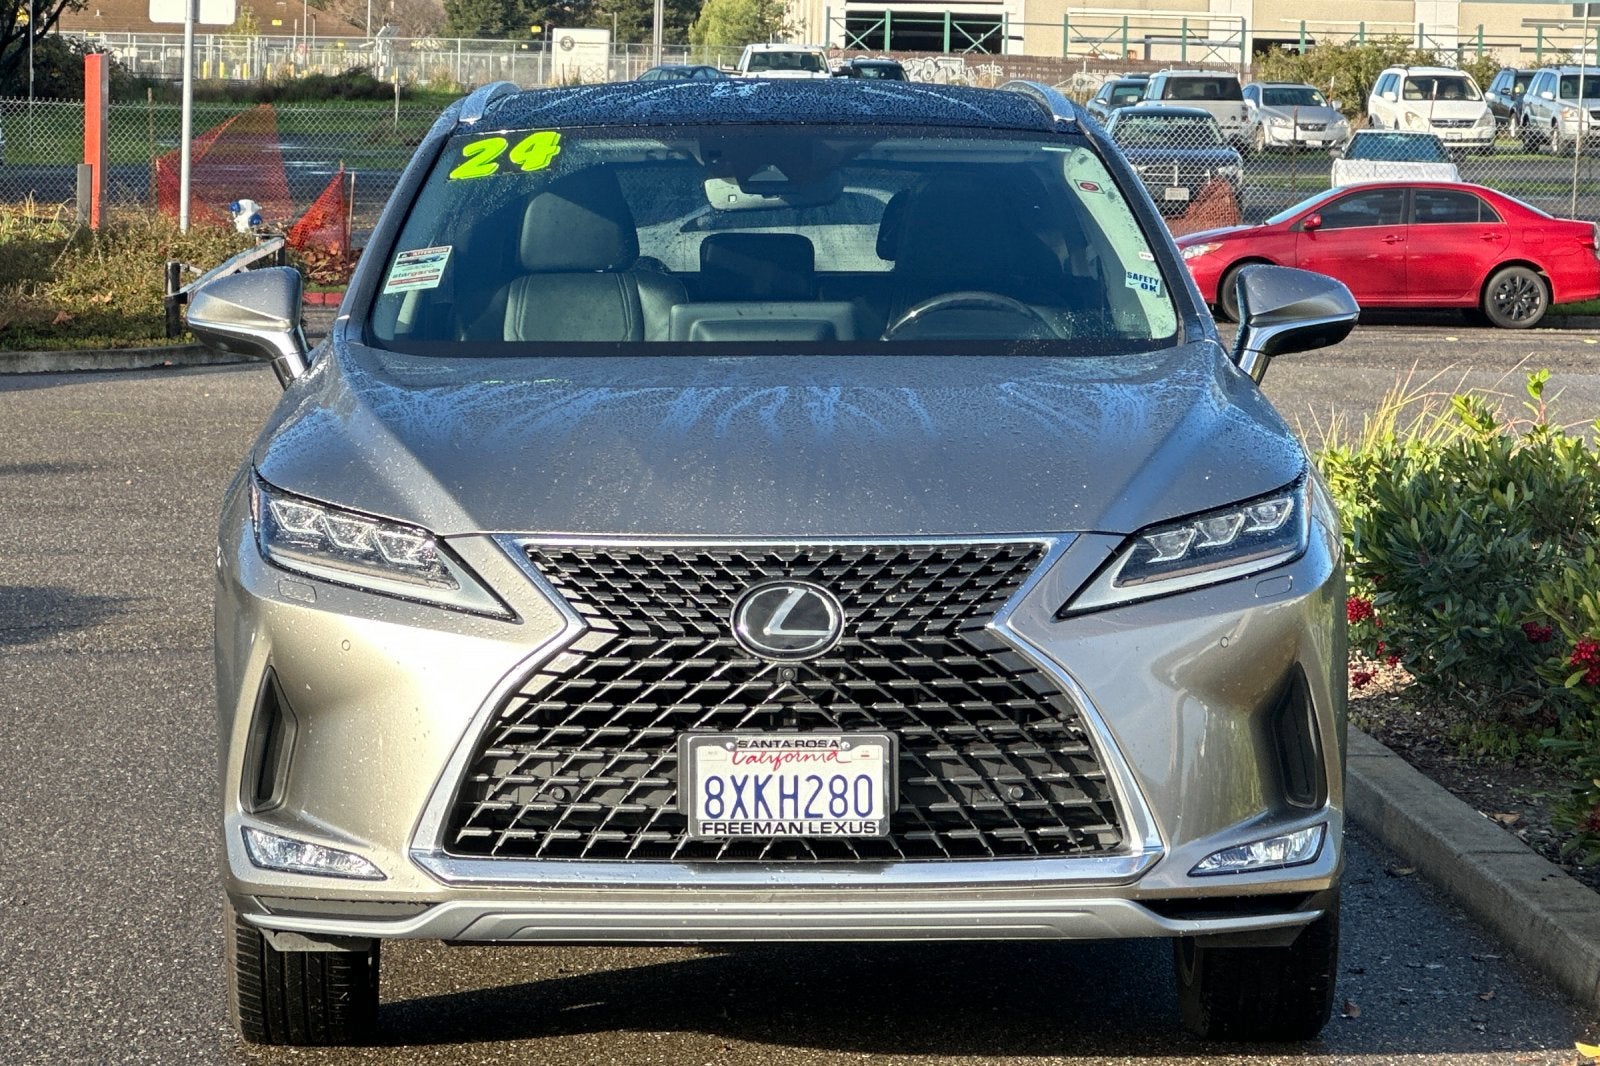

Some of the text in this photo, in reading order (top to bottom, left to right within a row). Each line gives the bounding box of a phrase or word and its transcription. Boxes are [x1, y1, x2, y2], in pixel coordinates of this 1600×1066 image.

[450, 131, 561, 180] 24
[1127, 271, 1160, 286] SAFETY
[1140, 282, 1157, 292] OK
[737, 740, 840, 749] SANTA ROSA
[732, 749, 852, 772] California
[704, 774, 873, 819] 8XKH280
[701, 821, 877, 835] FREEMAN LEXUS
